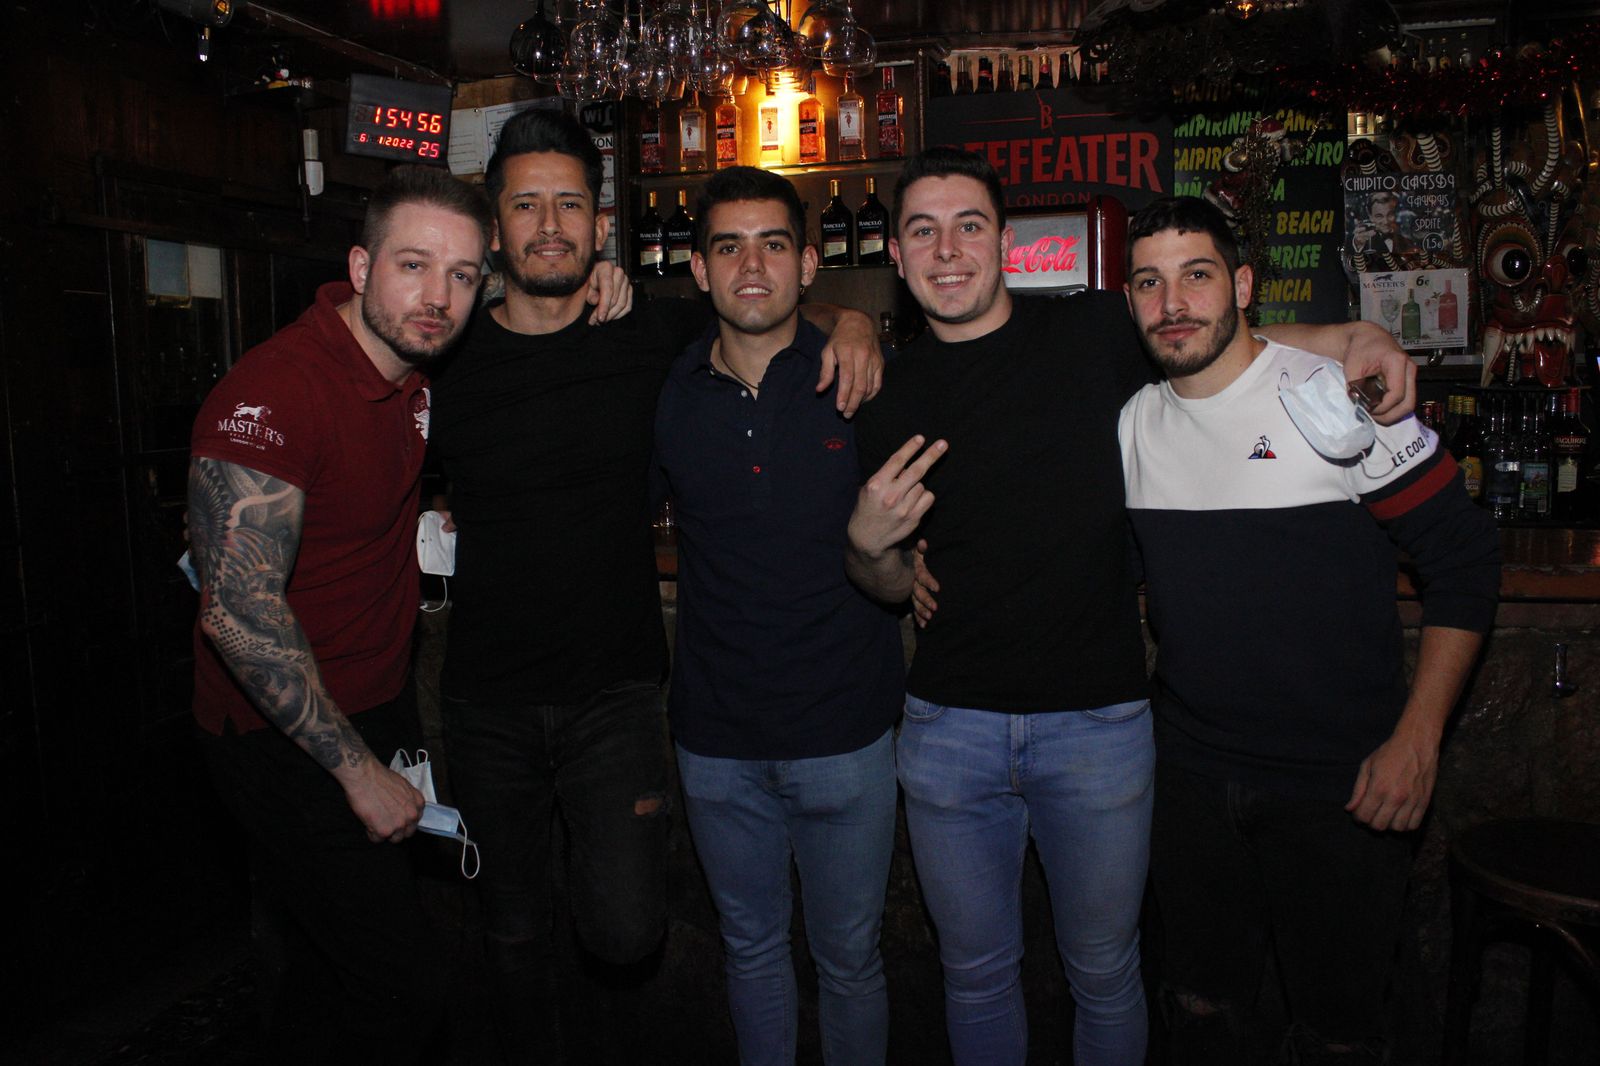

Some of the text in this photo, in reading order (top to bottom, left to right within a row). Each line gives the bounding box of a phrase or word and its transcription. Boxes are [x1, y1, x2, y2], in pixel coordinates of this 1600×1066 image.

[417, 141, 441, 159] 25
[962, 131, 1164, 193] EFEATER
[1345, 176, 1396, 191] CHUPITO
[1004, 192, 1090, 209] LONDON
[1276, 209, 1335, 236] BEACH
[1414, 218, 1441, 231] SPRITE
[1363, 280, 1406, 289] MASTER'S
[217, 418, 286, 447] MASTER'S
[1391, 436, 1427, 467] LE COQ
